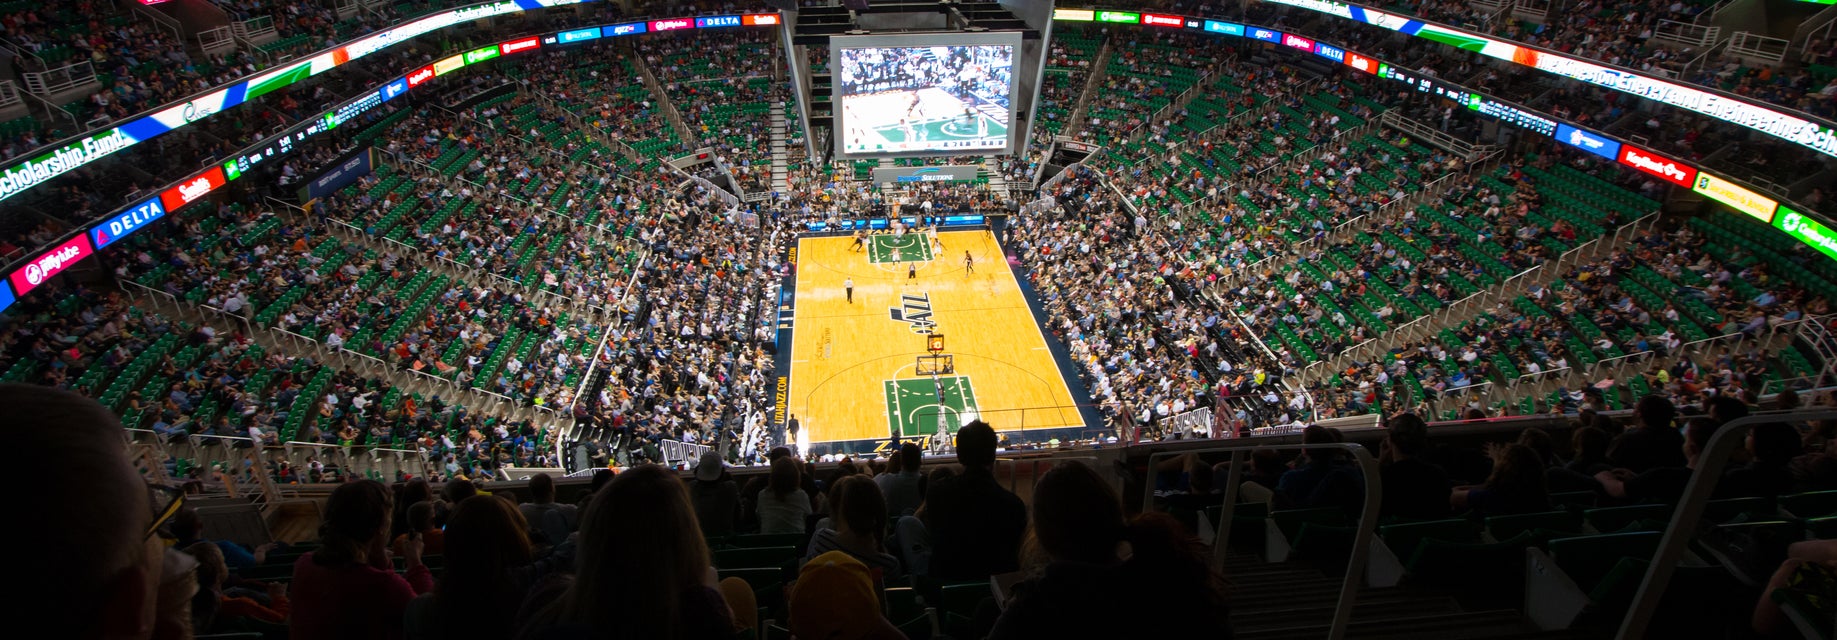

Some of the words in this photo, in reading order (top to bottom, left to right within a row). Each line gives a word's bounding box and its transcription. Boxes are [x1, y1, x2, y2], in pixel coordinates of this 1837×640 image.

[707, 17, 738, 26] DELTA
[1321, 46, 1343, 61] DELTA
[1706, 97, 1805, 143] Engineering
[82, 127, 124, 158] Fund
[921, 174, 954, 182] SOLUTIONS
[110, 202, 162, 236] DELTA
[774, 376, 787, 425] UTAHJAZZ.COM
